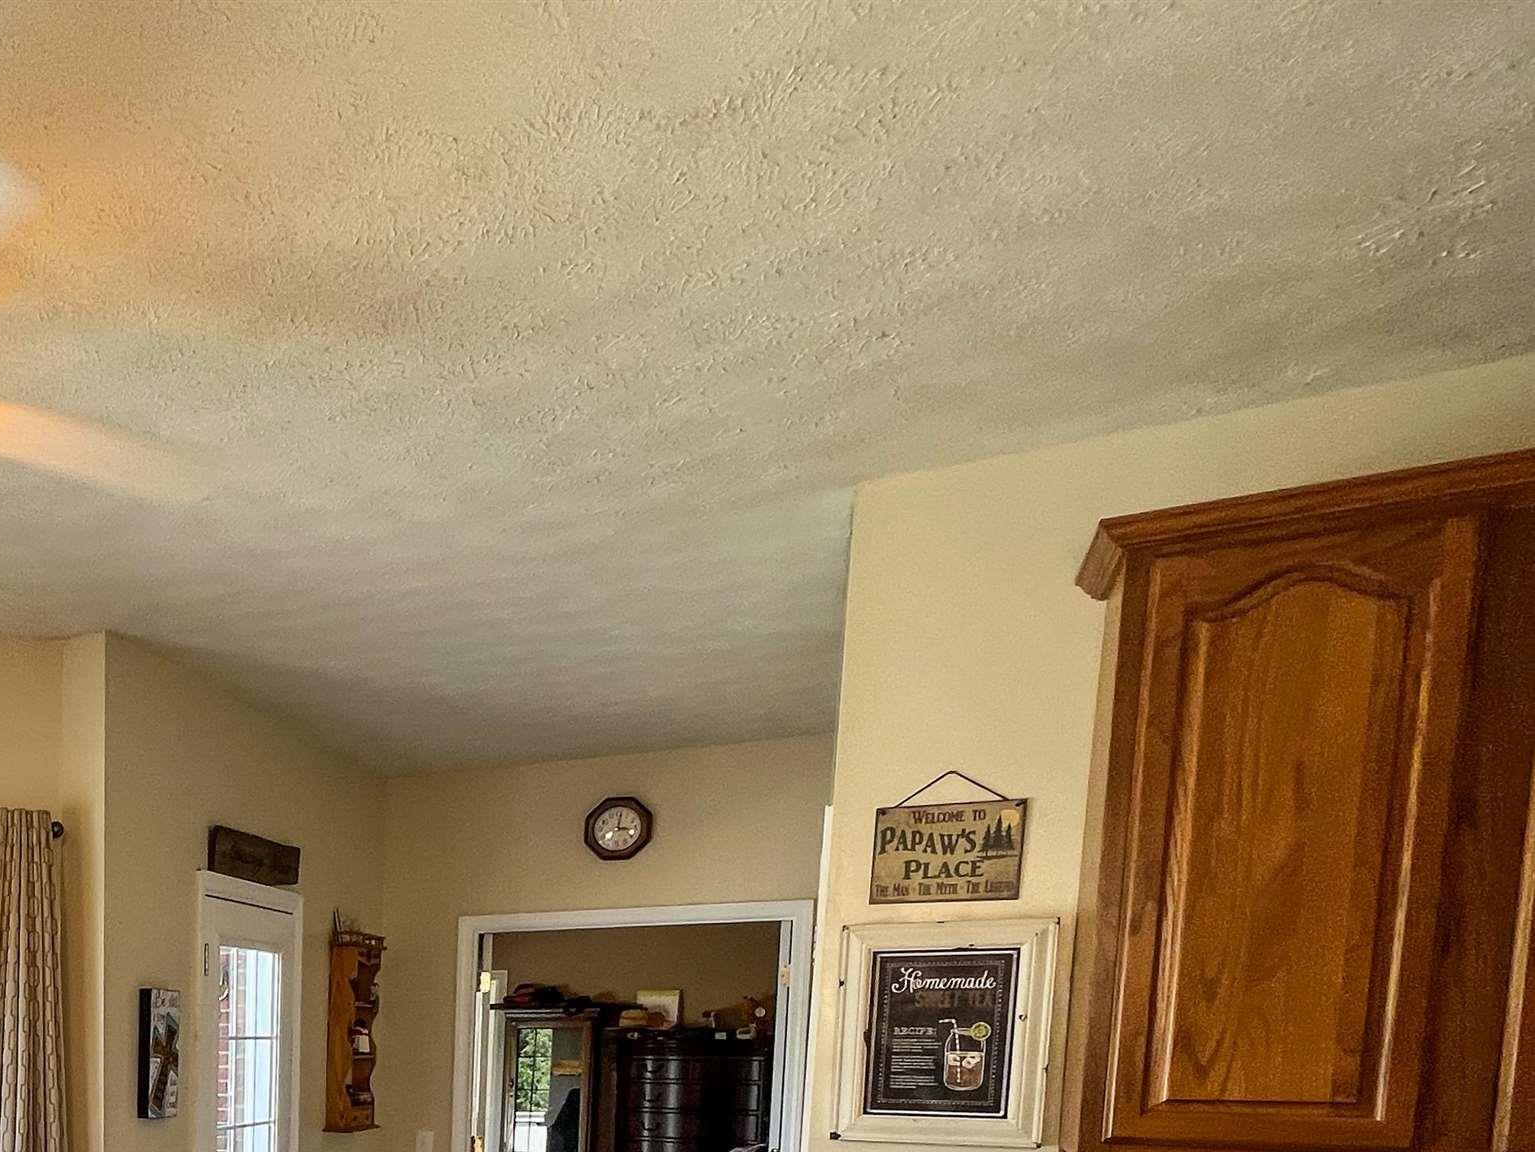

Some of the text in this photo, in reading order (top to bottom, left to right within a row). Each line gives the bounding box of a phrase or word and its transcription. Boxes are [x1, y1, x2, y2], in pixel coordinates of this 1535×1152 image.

[912, 809, 986, 824] WELCOME TO
[878, 826, 977, 855] PAPAW'S
[902, 859, 985, 880] PLACE
[891, 967, 996, 993] Homemade
